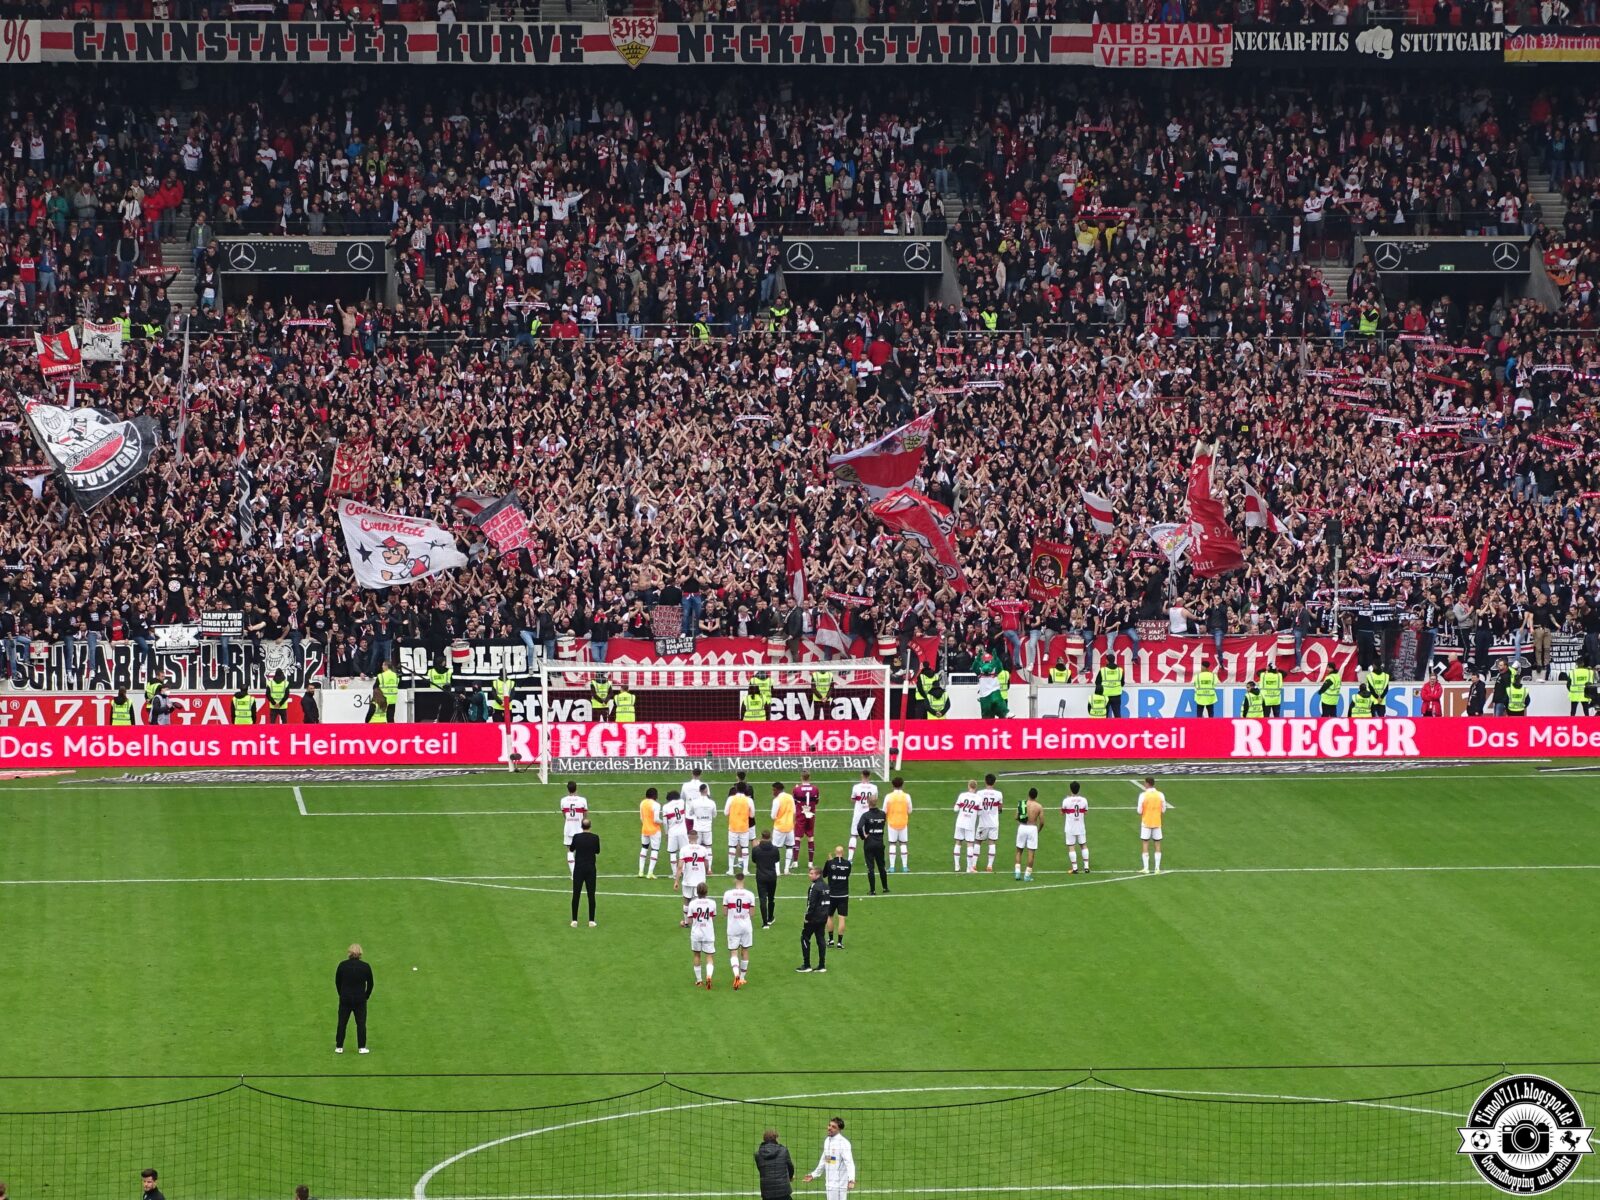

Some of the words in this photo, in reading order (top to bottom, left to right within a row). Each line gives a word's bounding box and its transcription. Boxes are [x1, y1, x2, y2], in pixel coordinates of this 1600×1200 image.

[73, 22, 409, 62] CANNSTATTER
[436, 24, 584, 63] KURVE
[677, 25, 1053, 64] NECKARSTADION
[1234, 31, 1349, 51] NECKAR-FILS
[1400, 32, 1504, 52] STUTTGART
[1510, 34, 1537, 51] Old
[1101, 47, 1225, 68] VFB-FANS
[202, 612, 226, 620] KAMPF
[228, 612, 242, 620] UND
[666, 642, 693, 650] IMMER
[1, 736, 53, 758] Das
[64, 735, 220, 758] Möbelhaus
[231, 734, 280, 756] mit
[290, 733, 457, 756] Heimvorteil
[498, 723, 688, 763] RIEGER
[738, 730, 790, 752] Das
[801, 730, 953, 752] Möbelhaus
[964, 729, 1011, 750] mit
[1021, 727, 1186, 750] Heimvorteil
[1231, 719, 1420, 757] RIEGER
[1467, 726, 1519, 748] Das
[1529, 726, 1600, 748] Möbe
[559, 758, 669, 771] Mercedes-Benz
[676, 757, 713, 771] Bank
[728, 756, 840, 770] Mercedes-Benz
[844, 755, 880, 769] Bank
[805, 792, 810, 805] 1
[692, 852, 698, 866] 2
[697, 907, 709, 922] 24
[736, 898, 742, 913] 9
